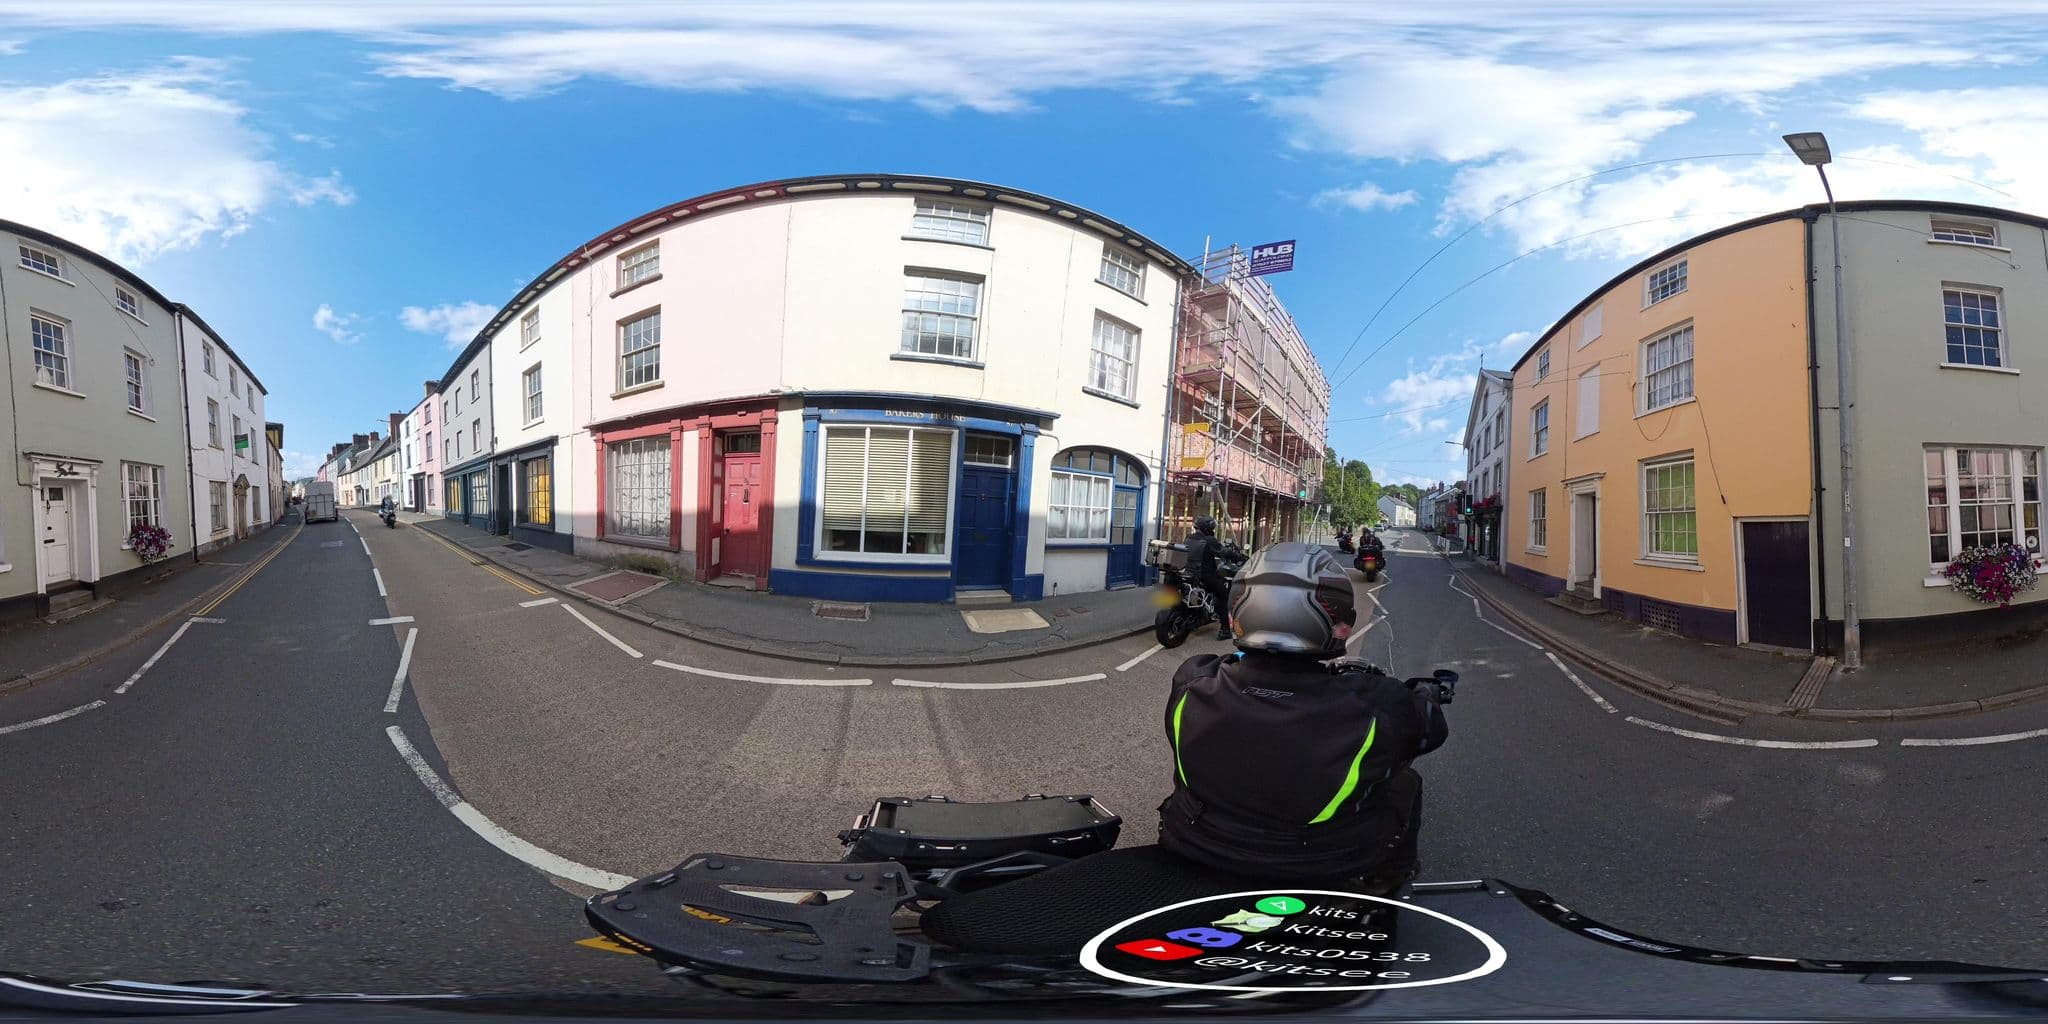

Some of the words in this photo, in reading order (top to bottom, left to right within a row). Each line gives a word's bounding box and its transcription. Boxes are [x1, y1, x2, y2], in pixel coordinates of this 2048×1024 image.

[1253, 244, 1293, 259] HUB
[885, 409, 924, 419] BAKERS
[930, 411, 966, 422] HOUSE
